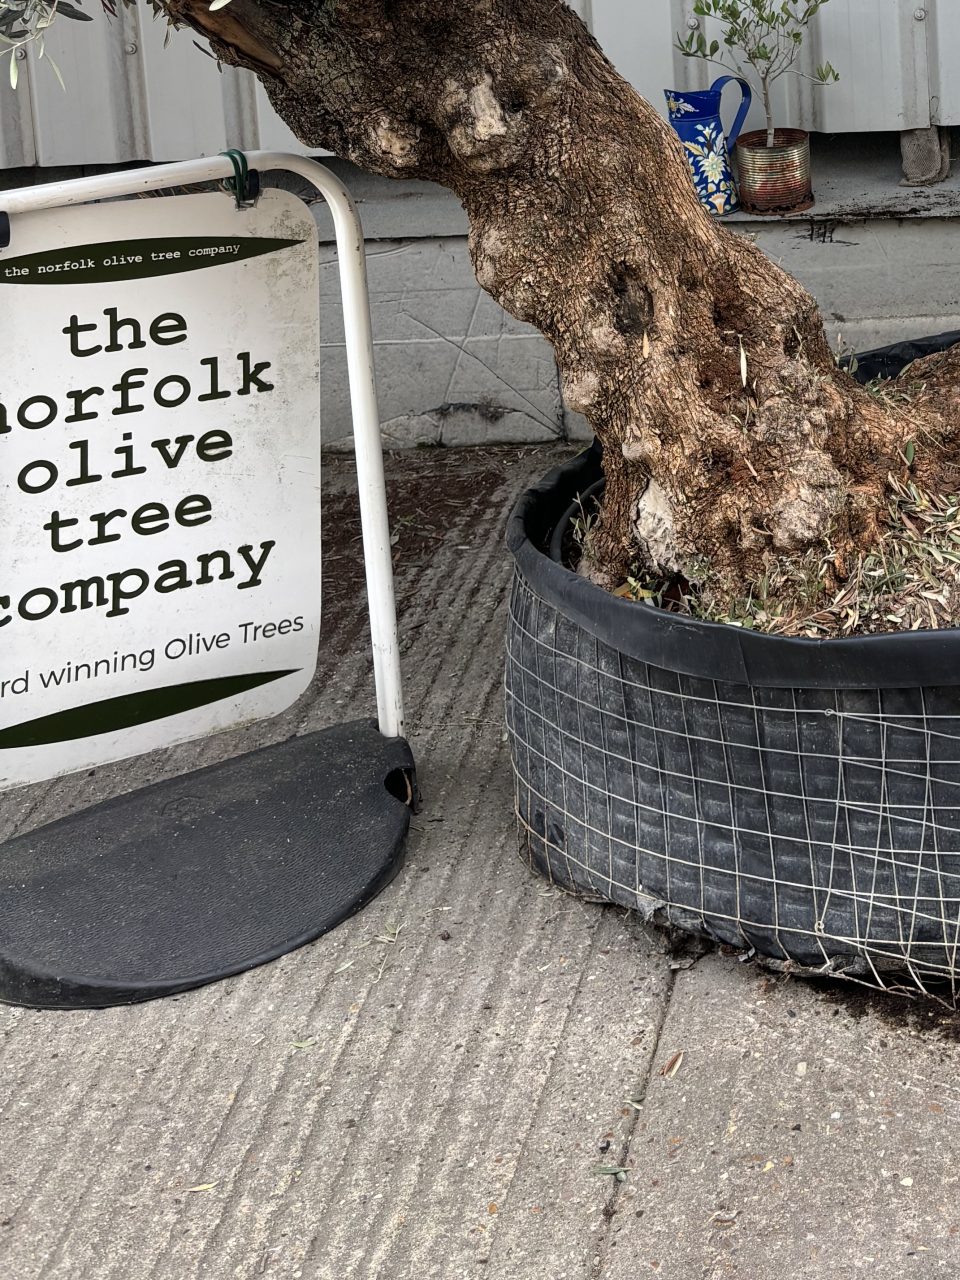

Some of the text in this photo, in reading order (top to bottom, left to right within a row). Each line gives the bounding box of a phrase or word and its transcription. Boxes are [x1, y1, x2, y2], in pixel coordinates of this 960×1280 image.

[5, 243, 241, 278] the norfolk olive tree company
[62, 307, 188, 358] the
[17, 429, 233, 495] olive
[43, 494, 212, 553] tree
[39, 648, 155, 689] winning
[164, 632, 231, 660] Olive
[238, 615, 304, 644] Trees
